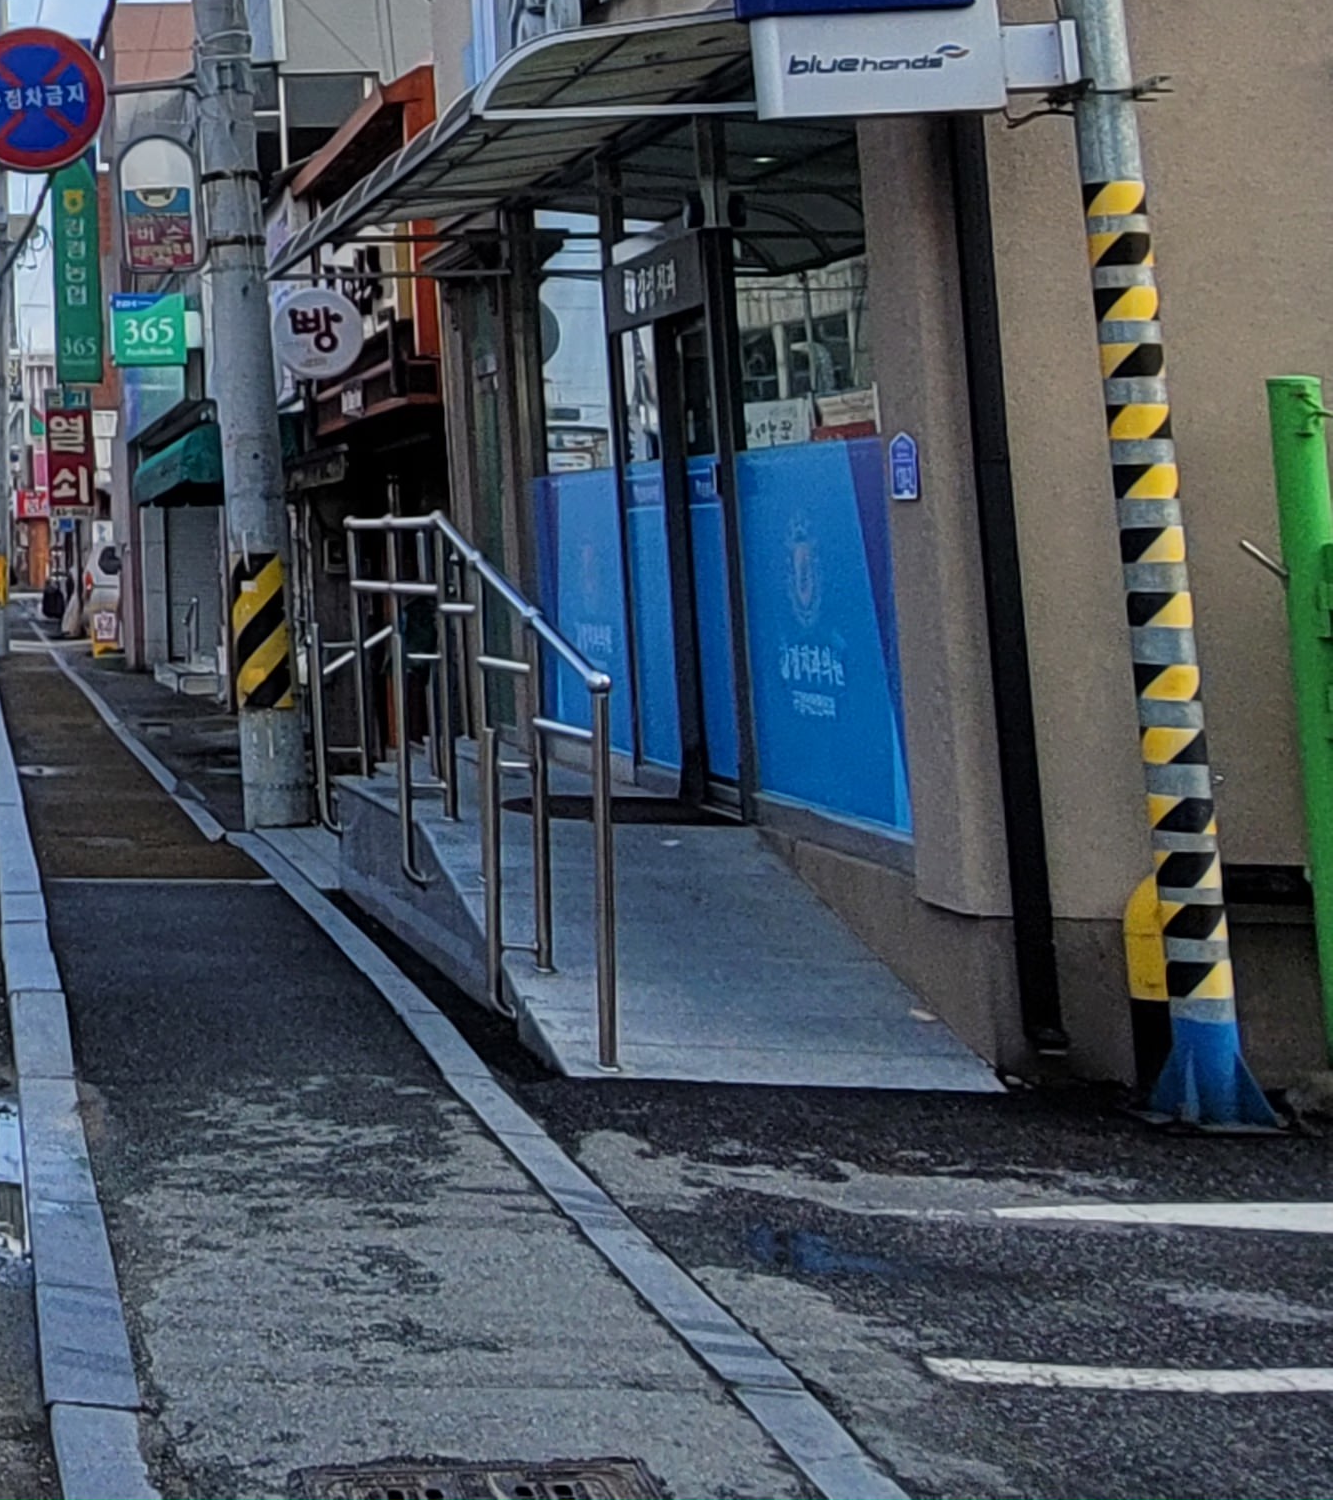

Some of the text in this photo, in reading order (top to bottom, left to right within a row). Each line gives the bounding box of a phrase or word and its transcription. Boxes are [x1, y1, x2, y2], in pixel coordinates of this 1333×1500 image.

[62, 337, 98, 357] 365
[124, 317, 175, 346] 365
[288, 306, 344, 353] 빵
[50, 414, 90, 505] 열쇠
